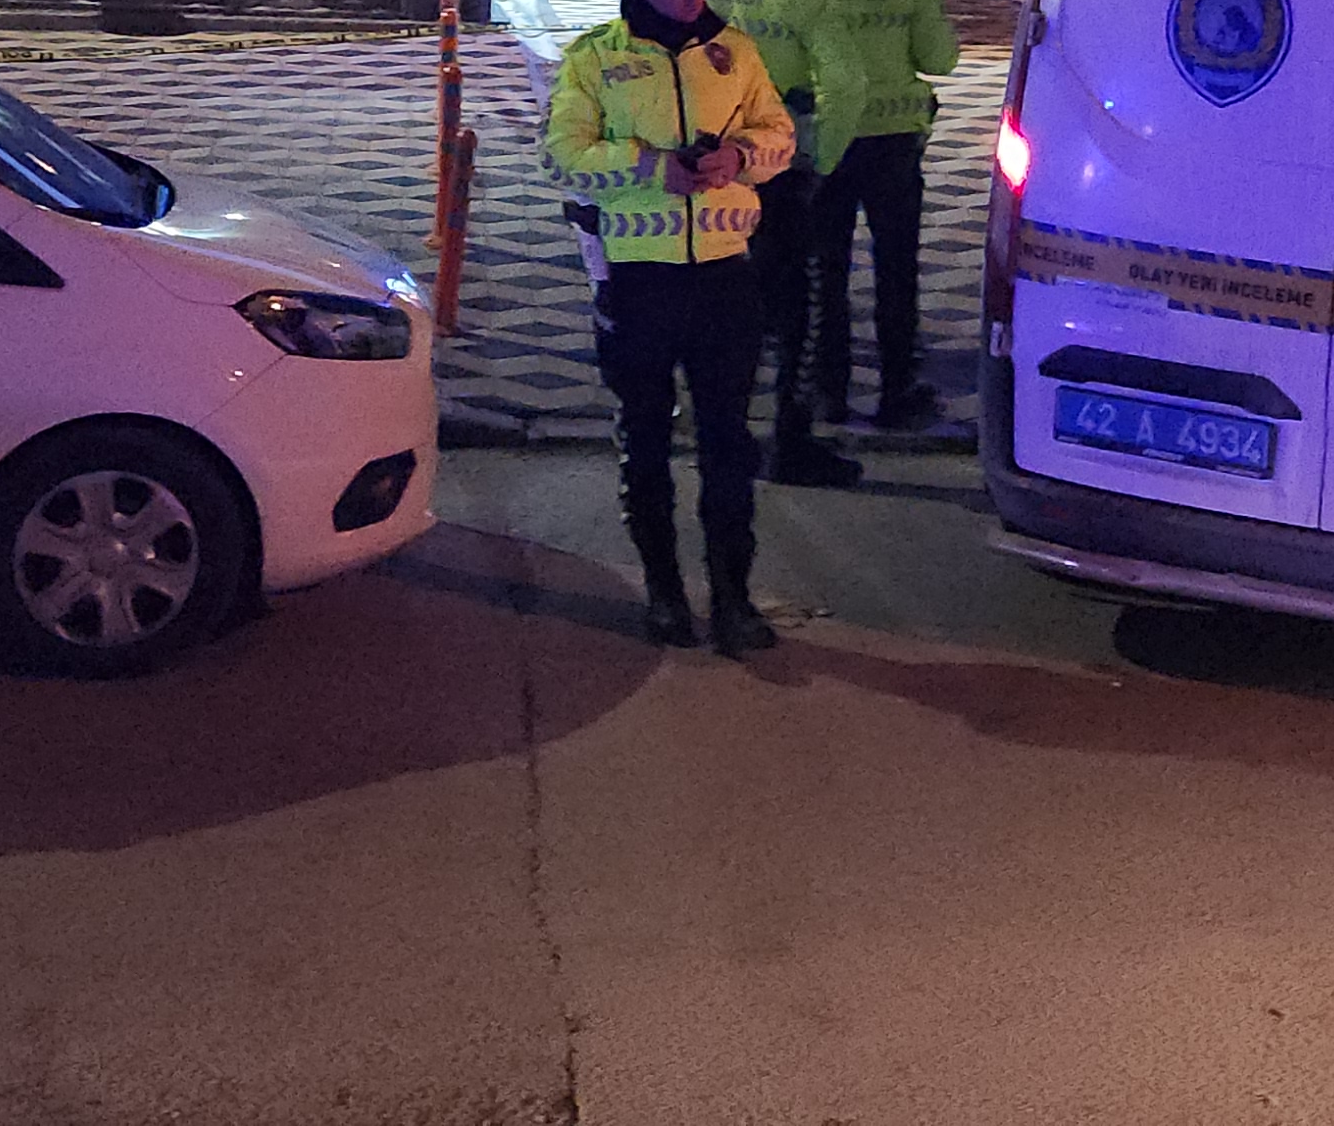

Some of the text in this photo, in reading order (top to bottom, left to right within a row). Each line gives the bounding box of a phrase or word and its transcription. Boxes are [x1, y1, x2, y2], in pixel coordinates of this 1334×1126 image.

[1128, 264, 1174, 286] OLAY
[1076, 400, 1262, 463] 42 A 4934
